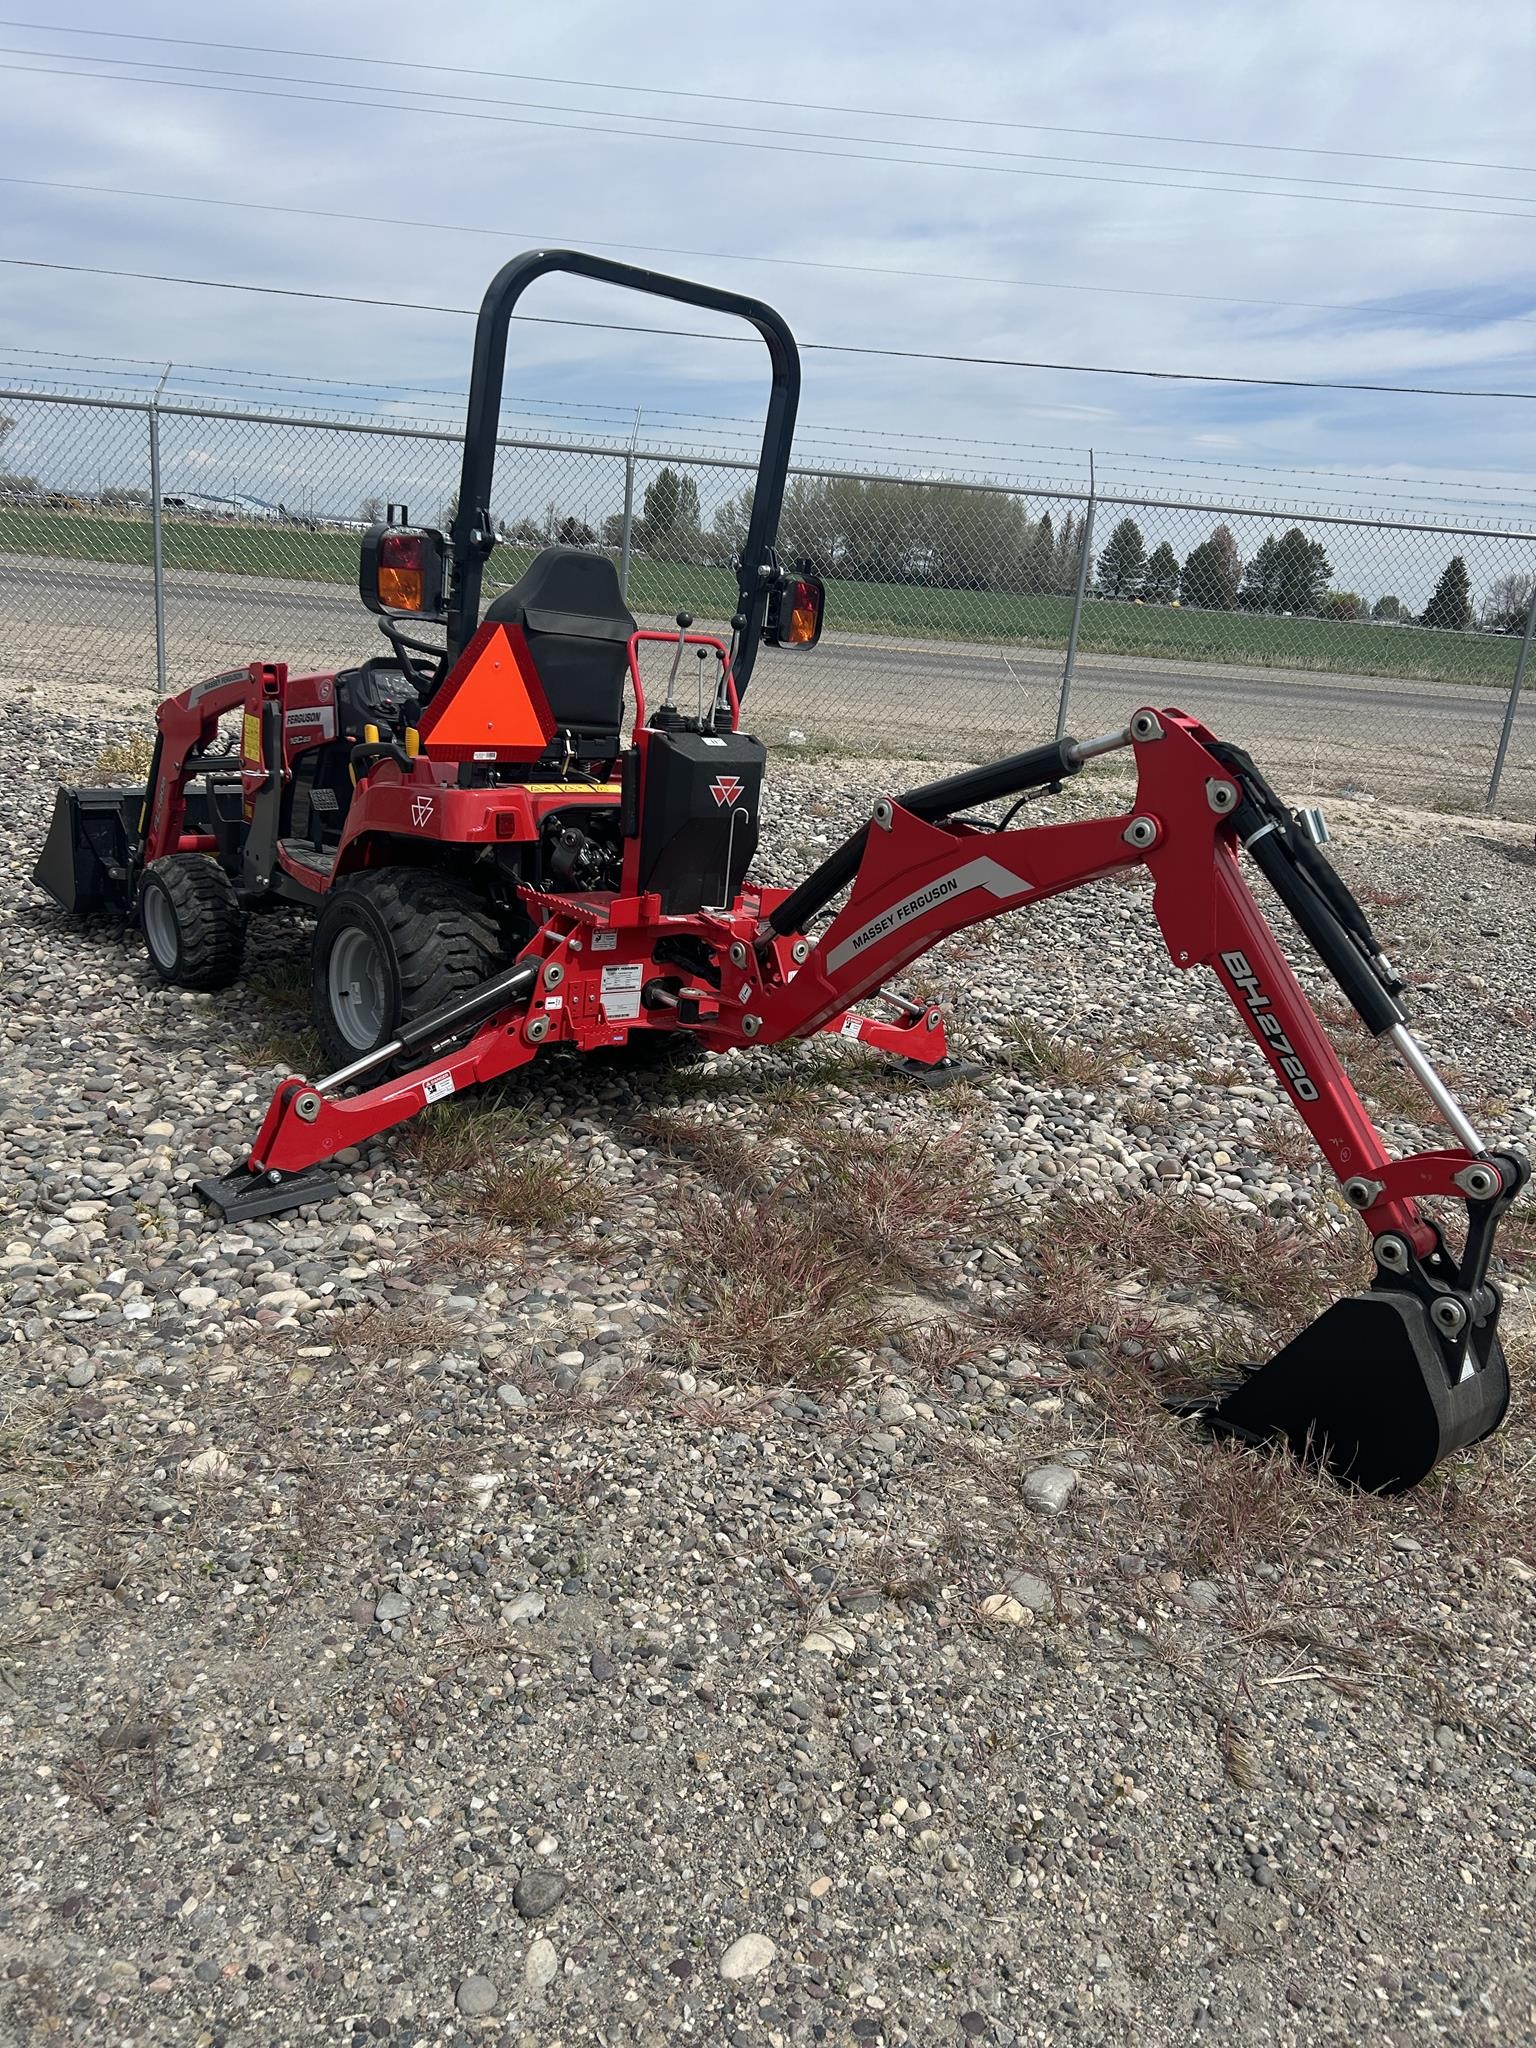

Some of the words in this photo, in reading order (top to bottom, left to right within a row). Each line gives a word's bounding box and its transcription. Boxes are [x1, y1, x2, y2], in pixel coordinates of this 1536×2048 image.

[221, 673, 244, 684] FERGUSON
[286, 711, 321, 725] FERGUSON
[852, 914, 895, 950] MASSEY
[896, 878, 958, 920] FERGUSON
[1220, 950, 1320, 1102] BH.2720
